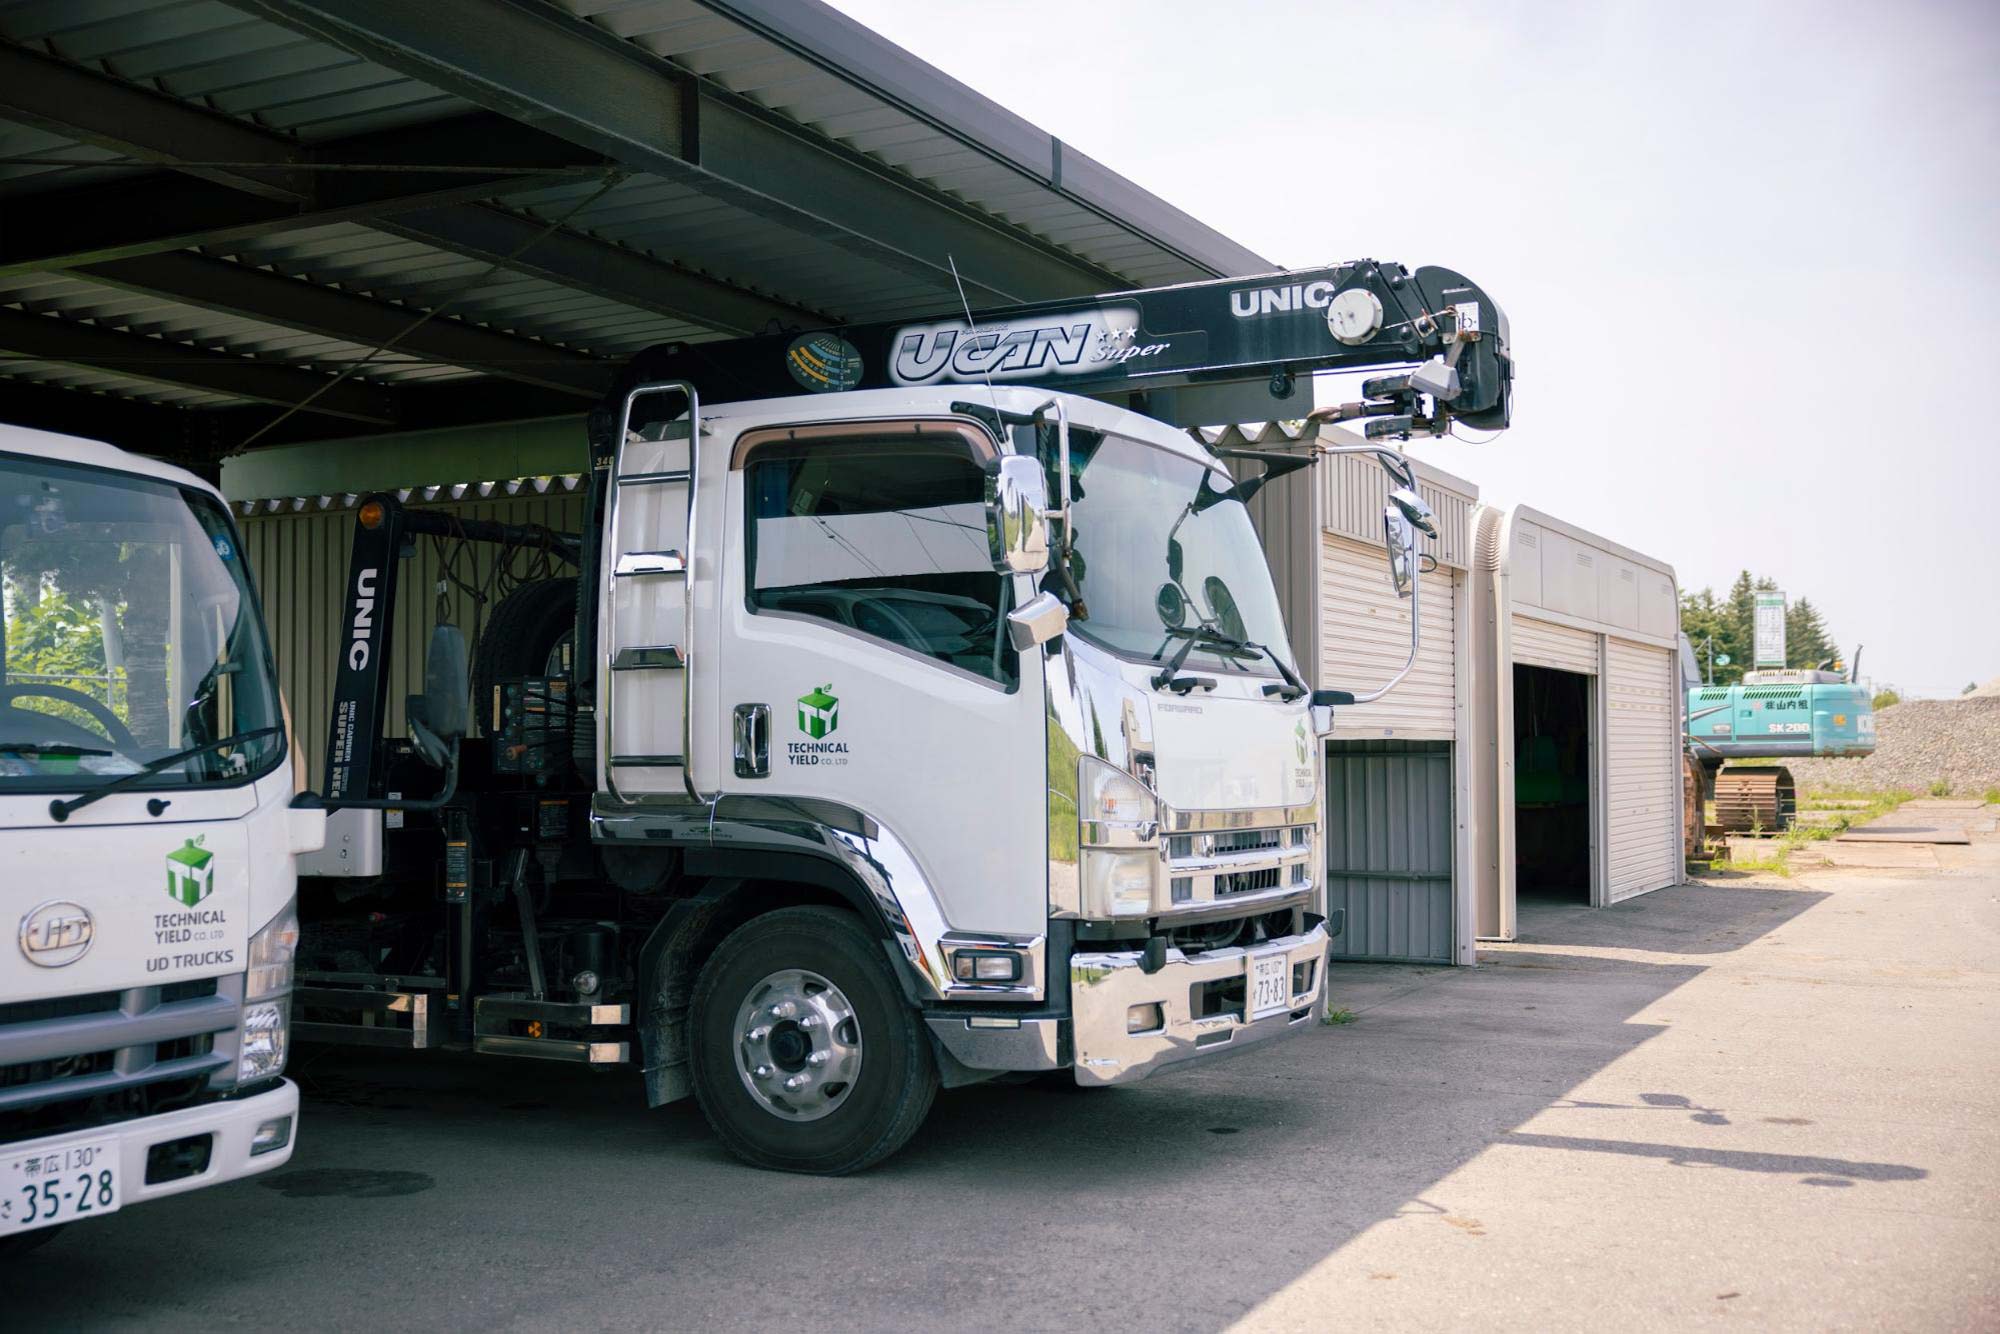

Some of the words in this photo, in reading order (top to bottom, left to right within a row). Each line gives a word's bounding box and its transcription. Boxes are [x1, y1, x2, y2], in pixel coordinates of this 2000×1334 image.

[1231, 281, 1334, 317] UNIC
[896, 323, 1092, 382] UCAN
[1089, 341, 1171, 364] Super
[349, 568, 377, 671] UNIC
[348, 700, 356, 722] UNIC
[334, 701, 348, 763] SUPER
[787, 743, 849, 753] TECHNICAL
[788, 755, 819, 765] YIELD
[154, 910, 226, 929] TECHNICAL
[155, 929, 192, 944] YIELD
[146, 957, 169, 972] UD
[172, 950, 234, 969] TRUCKS
[21, 1169, 113, 1224] 35-28
